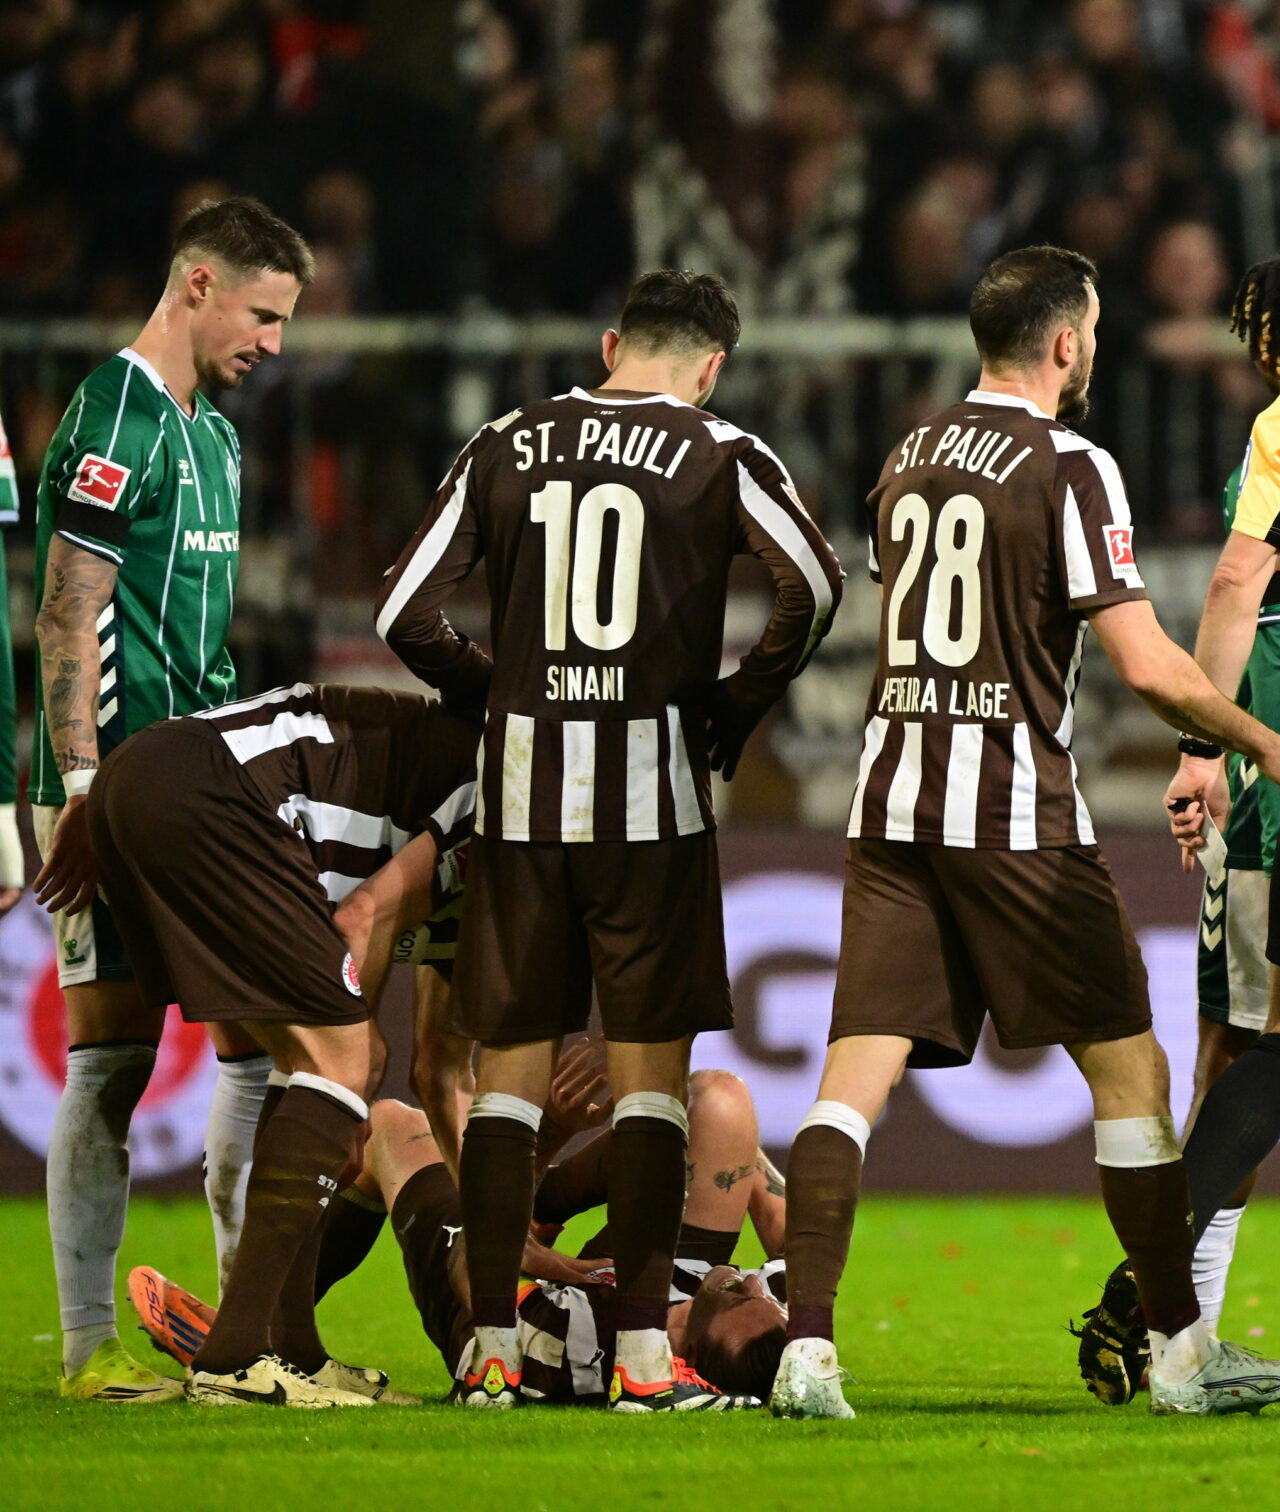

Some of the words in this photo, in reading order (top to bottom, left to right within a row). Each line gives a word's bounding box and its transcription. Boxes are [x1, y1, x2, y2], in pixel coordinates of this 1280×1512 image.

[512, 421, 565, 471] ST.
[576, 417, 692, 480] PAULI
[894, 426, 932, 475] ST.
[930, 424, 1034, 485] PAULI
[530, 480, 645, 651] 10
[888, 492, 986, 668] 28
[545, 665, 624, 702] SINANI
[948, 679, 1010, 719] LAGE
[140, 1272, 166, 1328] F50
